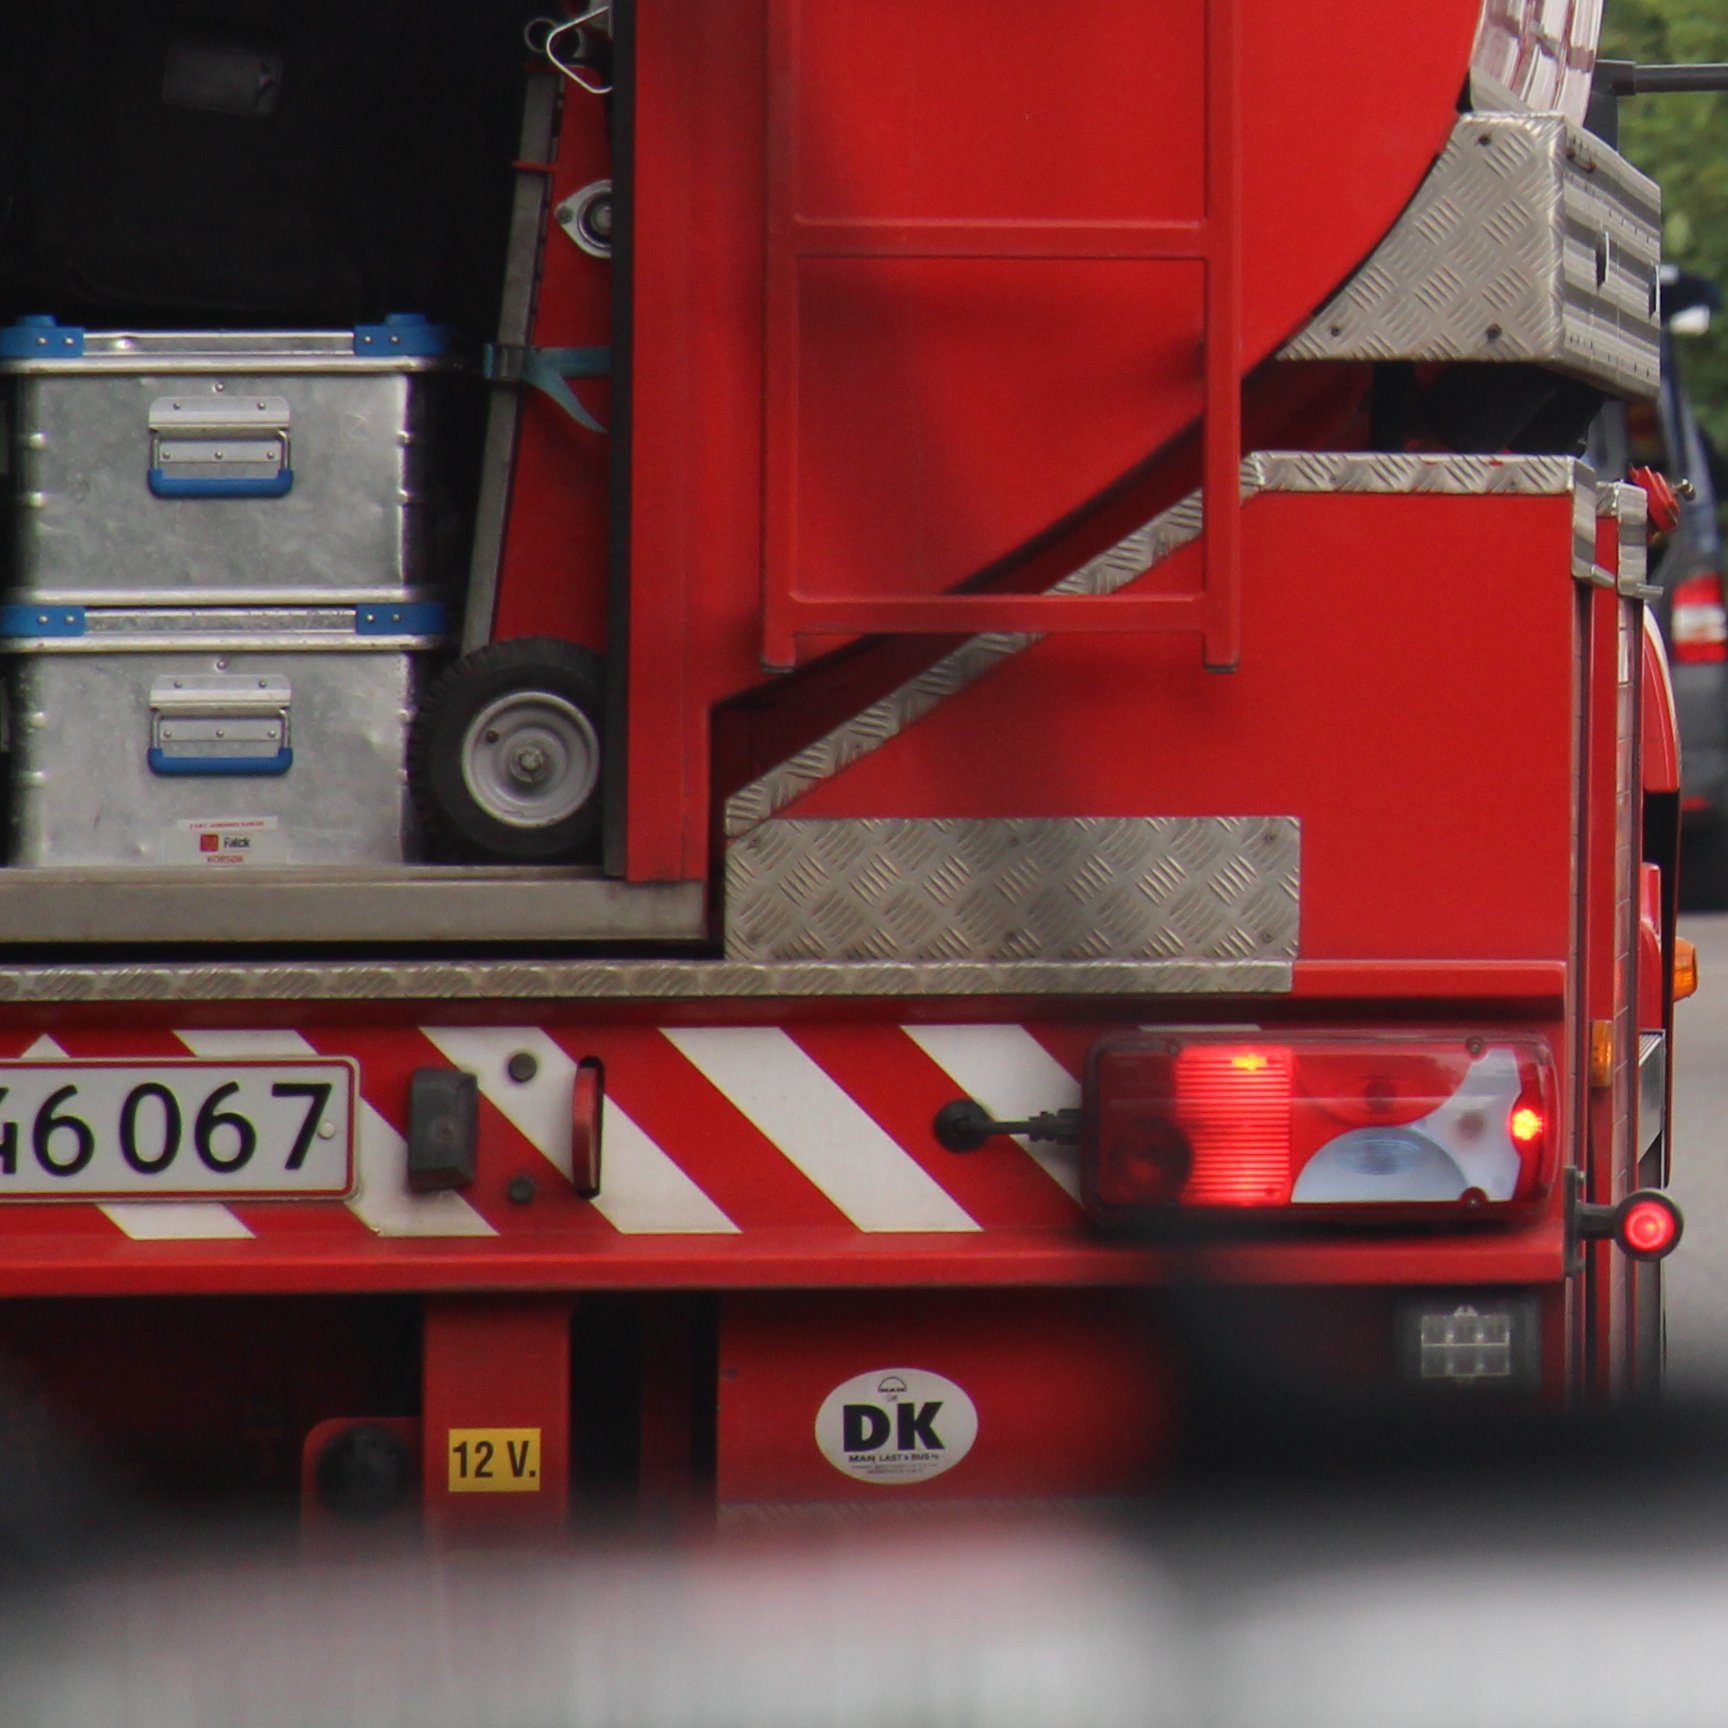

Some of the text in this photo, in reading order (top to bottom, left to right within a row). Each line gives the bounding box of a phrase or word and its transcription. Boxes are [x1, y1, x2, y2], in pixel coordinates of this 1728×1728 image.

[843, 1401, 945, 1452] DK
[453, 1440, 537, 1478] 12 V.
[849, 1455, 876, 1463] MAN
[879, 1454, 901, 1462] LAST
